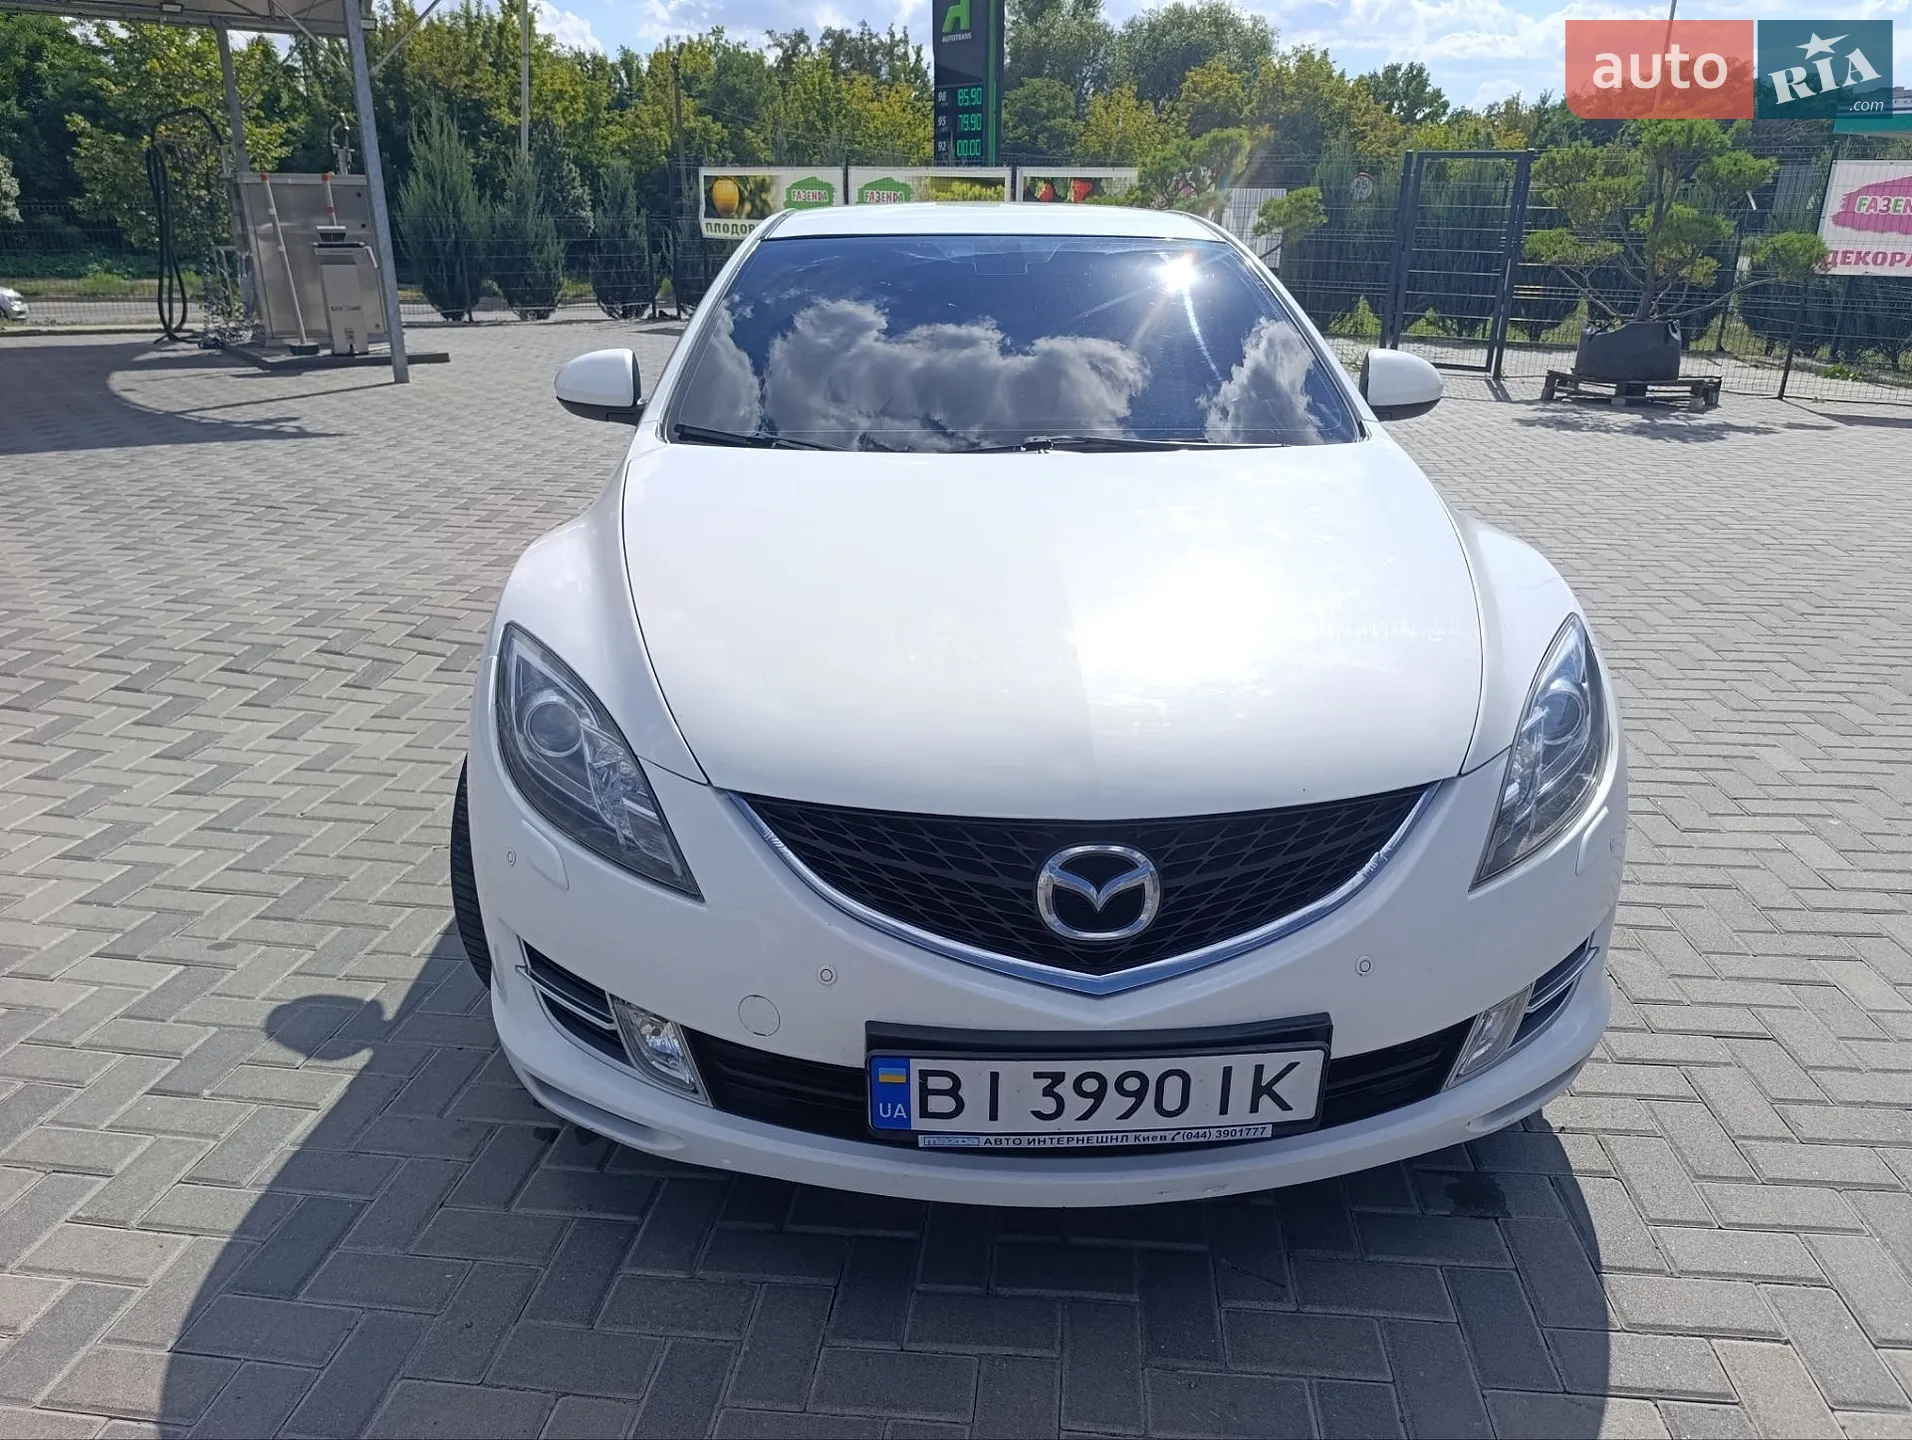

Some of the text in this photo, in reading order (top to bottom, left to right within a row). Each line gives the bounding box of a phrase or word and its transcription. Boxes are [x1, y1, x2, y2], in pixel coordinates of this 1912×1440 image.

[938, 115, 947, 127] 95
[705, 222, 759, 236] ПЛОДОР
[918, 1061, 1302, 1121] BI 3990 IK
[879, 1102, 907, 1119] UA
[983, 1137, 1022, 1146] АВТО
[1027, 1135, 1129, 1146] ИНТЕРНЕШНЛ
[1134, 1134, 1167, 1143] Киев
[1181, 1130, 1212, 1140] (044)
[1216, 1126, 1267, 1138] 3901777
